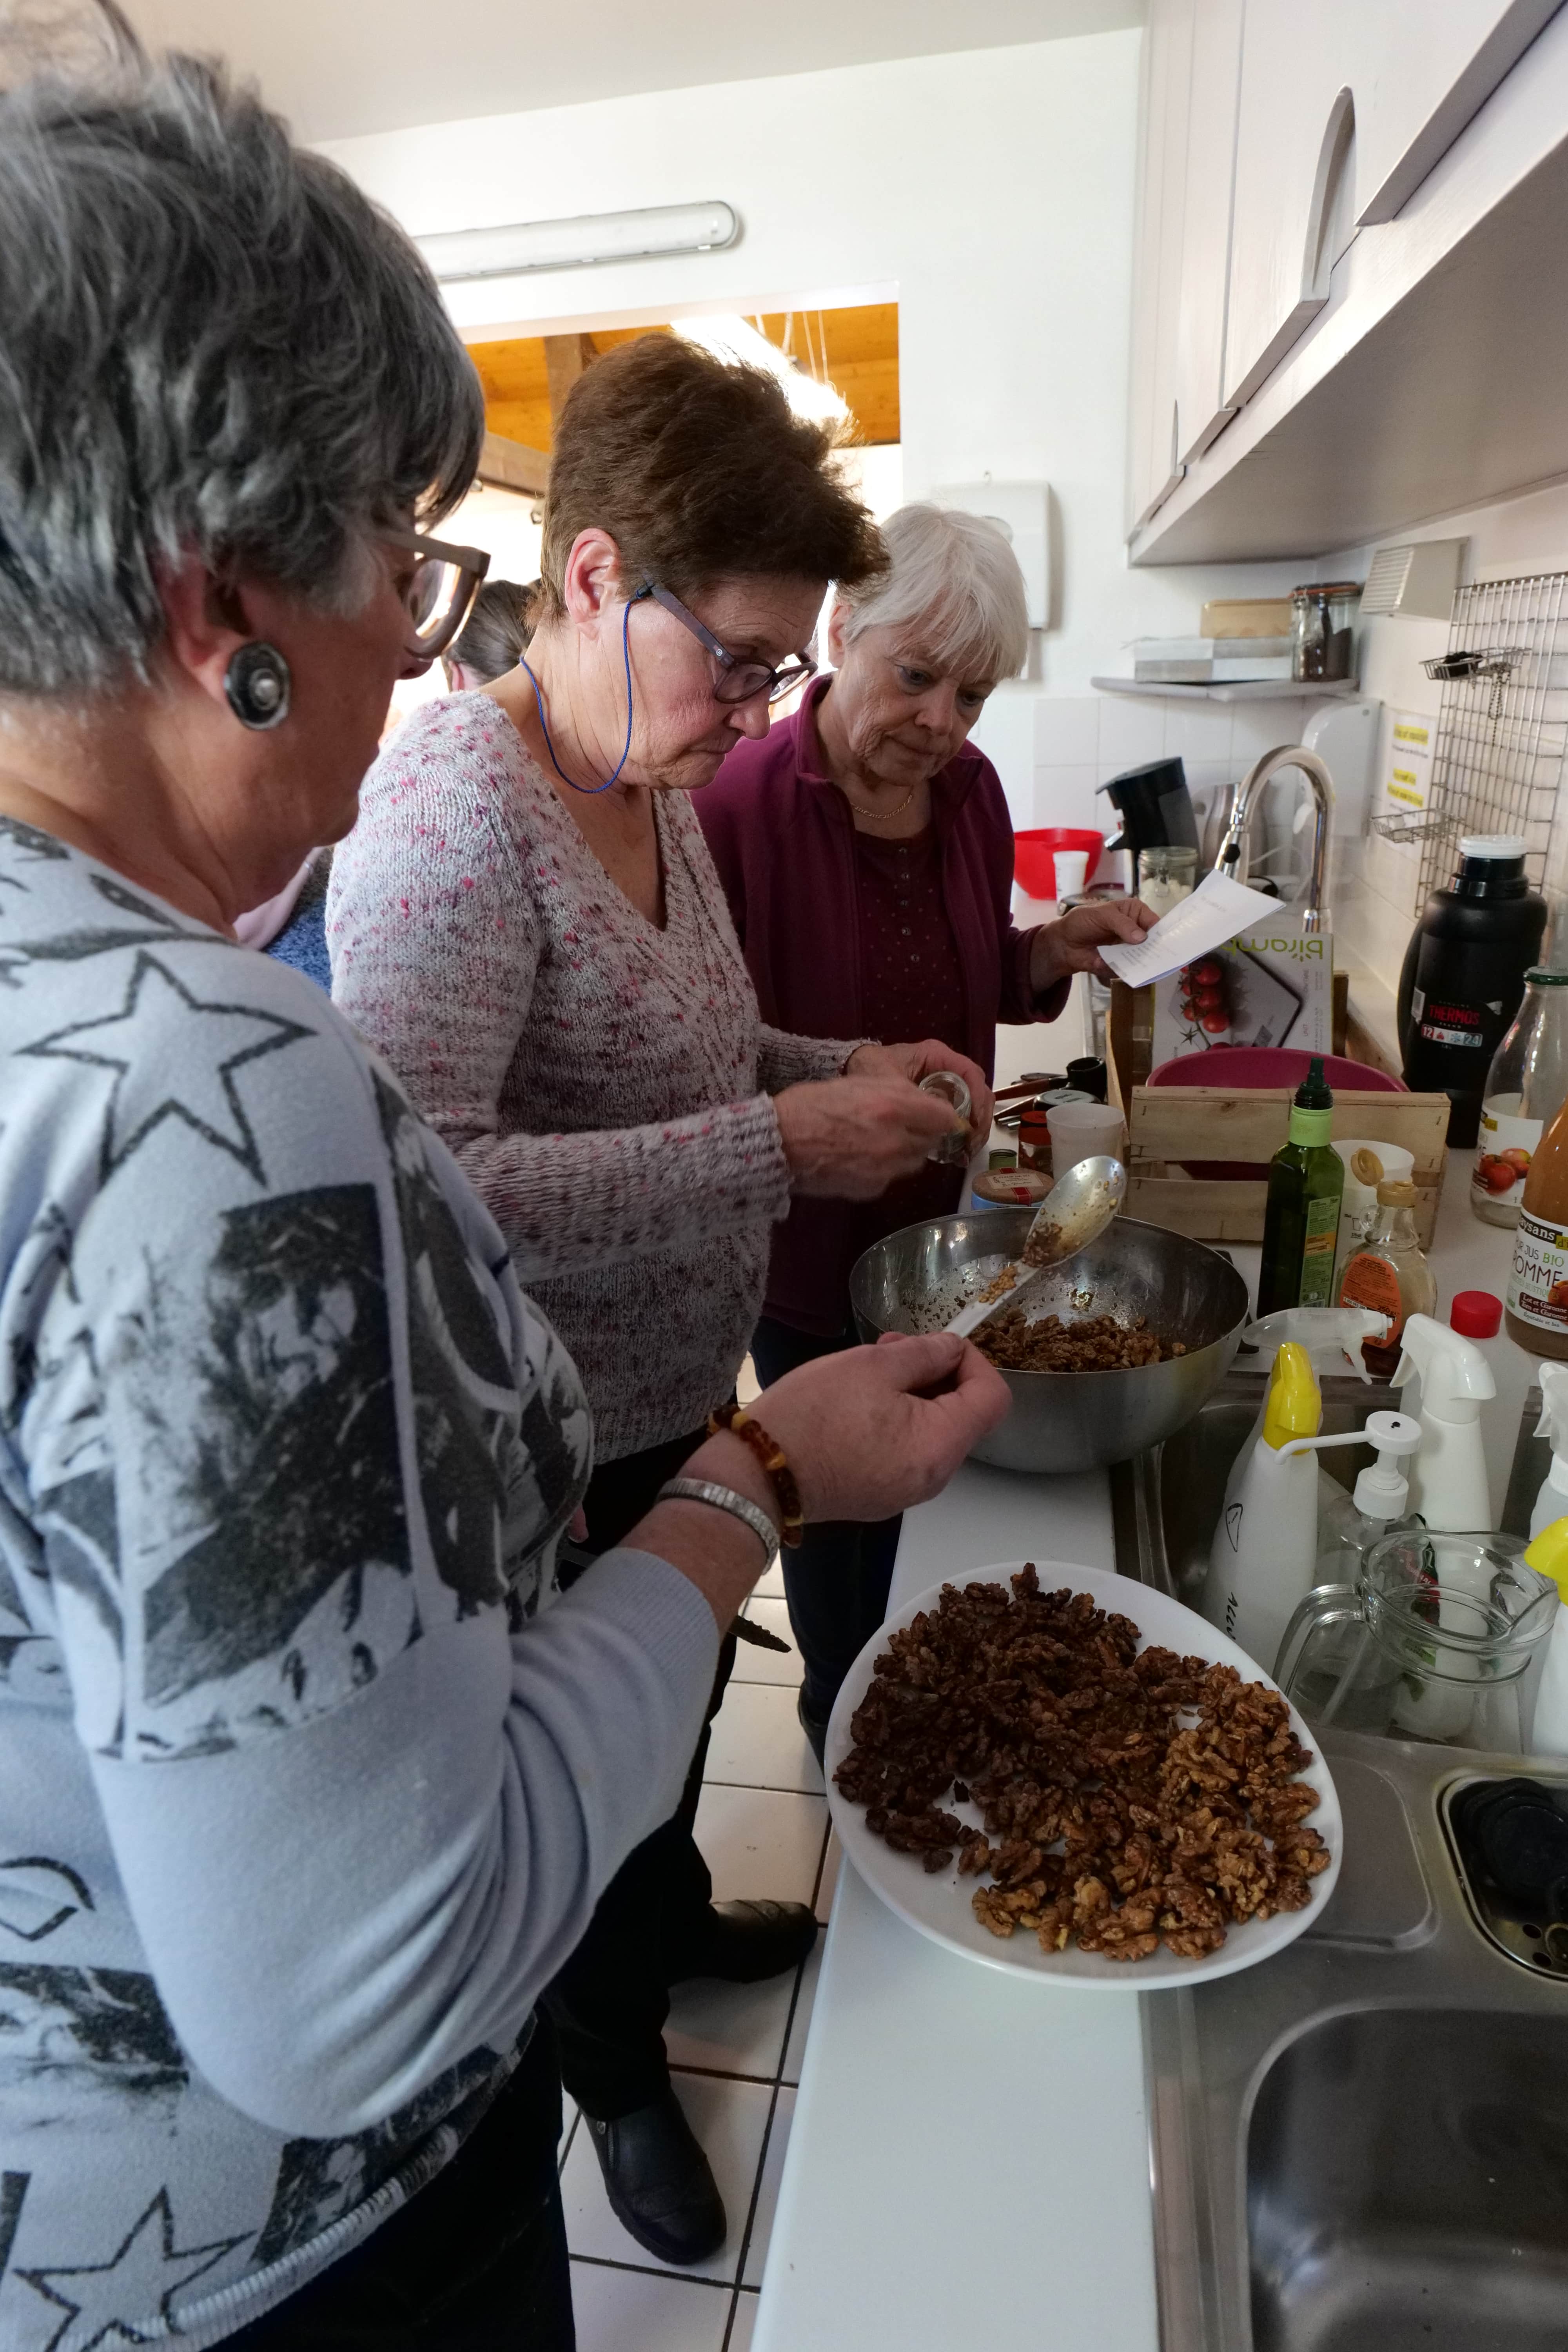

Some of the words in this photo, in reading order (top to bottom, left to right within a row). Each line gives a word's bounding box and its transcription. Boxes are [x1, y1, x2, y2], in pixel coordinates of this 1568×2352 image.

[1430, 1004, 1480, 1025] THERMOS
[1423, 1026, 1433, 1038] 12
[1465, 1034, 1480, 1045] 24
[1519, 1217, 1555, 1241] aysans
[1524, 1245, 1539, 1260] JUS
[1542, 1252, 1564, 1267] BIO
[1523, 1294, 1532, 1304] Lot
[1540, 1301, 1568, 1314] Garonne
[1541, 1308, 1568, 1321] Garonne
